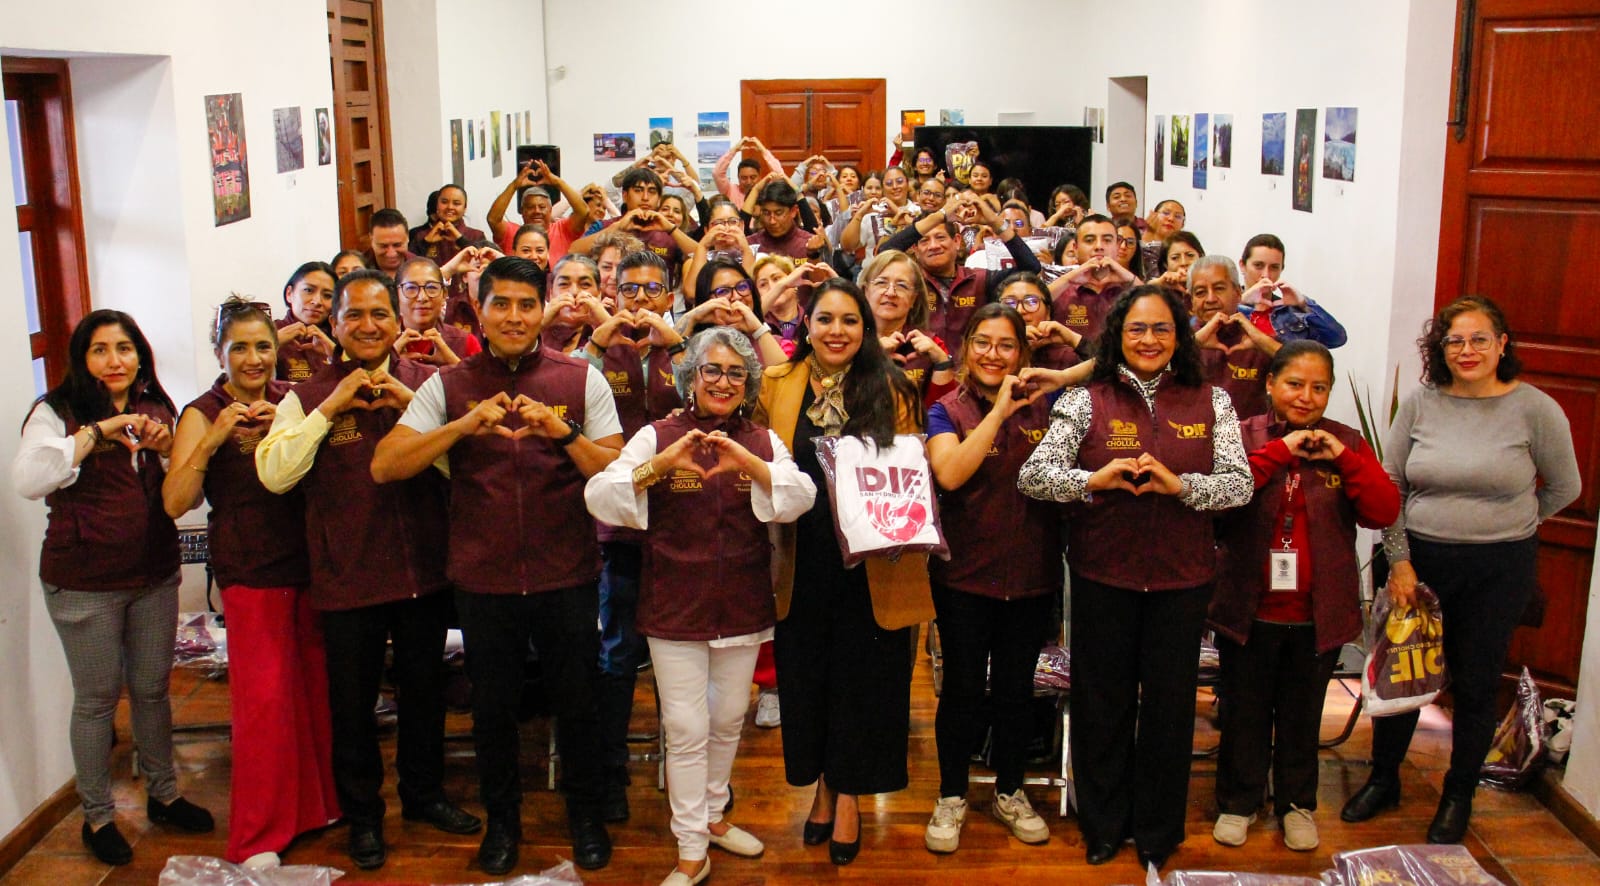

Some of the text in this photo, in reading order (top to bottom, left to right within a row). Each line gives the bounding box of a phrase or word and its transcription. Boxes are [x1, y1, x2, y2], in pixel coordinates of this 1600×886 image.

[959, 296, 976, 306] DIF
[1237, 368, 1258, 378] DIF
[1183, 423, 1206, 437] DIF
[1106, 440, 1141, 448] CHOLULA
